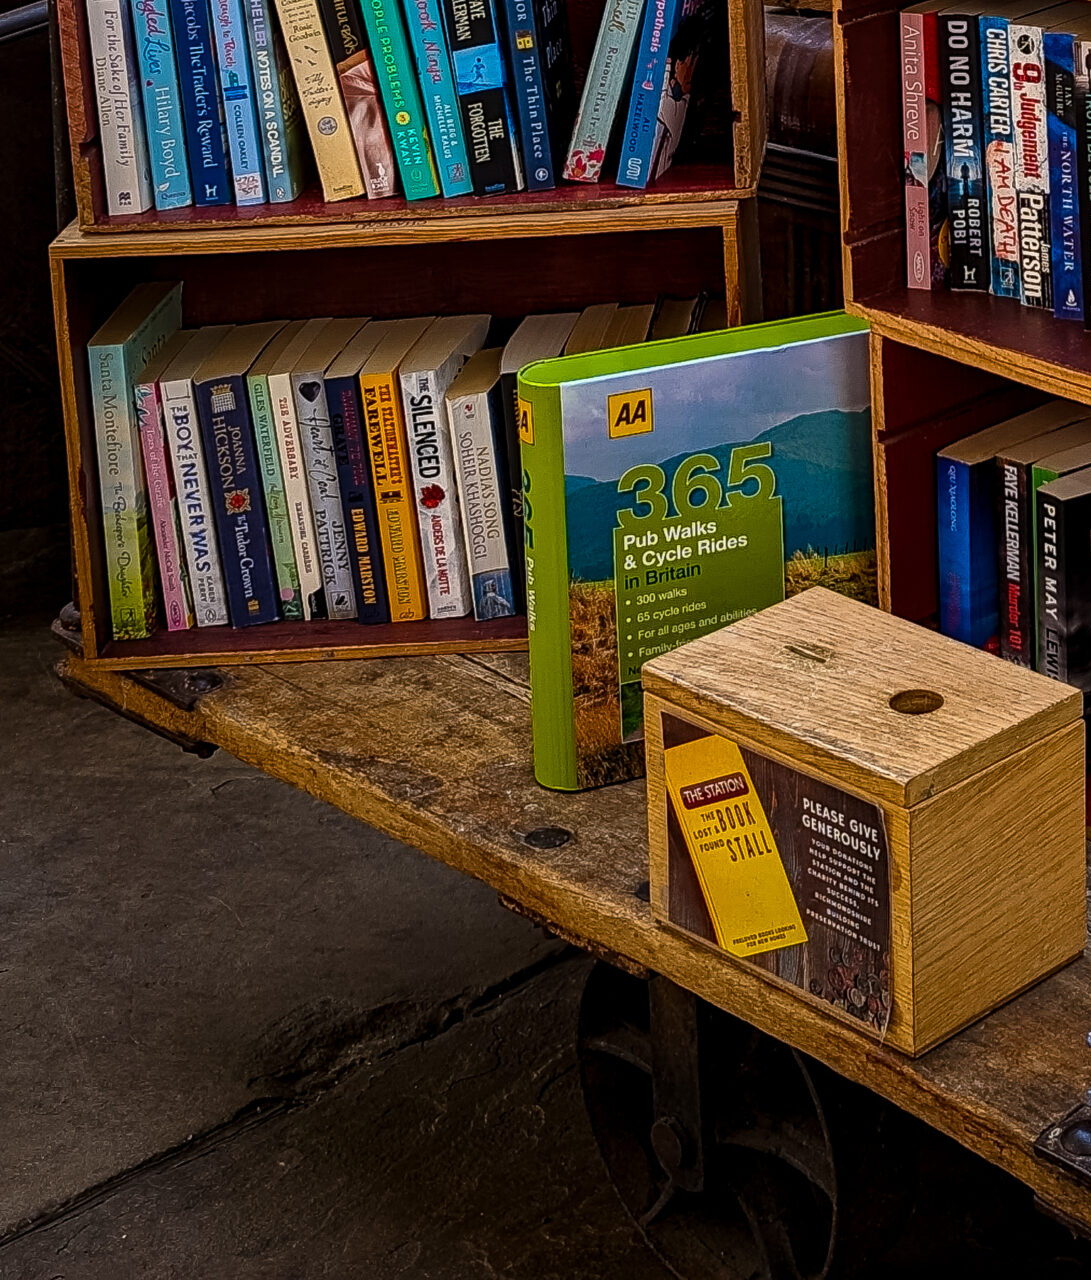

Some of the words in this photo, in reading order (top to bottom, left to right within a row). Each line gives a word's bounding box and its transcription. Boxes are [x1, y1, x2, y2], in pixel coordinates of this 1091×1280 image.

[948, 21, 968, 49] DO
[986, 28, 1007, 74] CHRIS
[950, 56, 970, 85] NO
[156, 87, 176, 135] Hilary
[951, 93, 974, 158] HARM
[989, 77, 1010, 135] CARTER
[468, 103, 490, 162] FORGOTTEN
[489, 118, 504, 140] THE
[160, 138, 180, 178] Boyd
[953, 210, 966, 244] POBI
[967, 199, 982, 256] ROBERT
[1019, 193, 1044, 298] Patterson
[615, 400, 647, 427] AA
[410, 395, 440, 479] SILENCED
[616, 442, 776, 527] 365
[352, 509, 367, 557] EDWARD
[623, 531, 660, 550] Pub
[662, 519, 718, 540] Walks
[623, 553, 636, 570] &
[642, 545, 693, 570] Cycle
[698, 533, 748, 557] Rides
[1043, 503, 1056, 569] PETER
[355, 560, 377, 604] MARSTON
[624, 574, 640, 589] in
[645, 562, 701, 584] Britain
[1045, 577, 1058, 619] MAY
[683, 789, 703, 804] THE
[704, 778, 743, 800] STATION
[693, 826, 714, 840] LOST
[714, 825, 721, 834] &
[701, 811, 715, 822] THE
[716, 802, 756, 832] BOOK
[802, 815, 881, 861] GENEROUSLY
[803, 798, 845, 826] PLEASE
[850, 816, 879, 843] GIVE
[700, 839, 725, 854] FOUND
[727, 831, 772, 863] STALL
